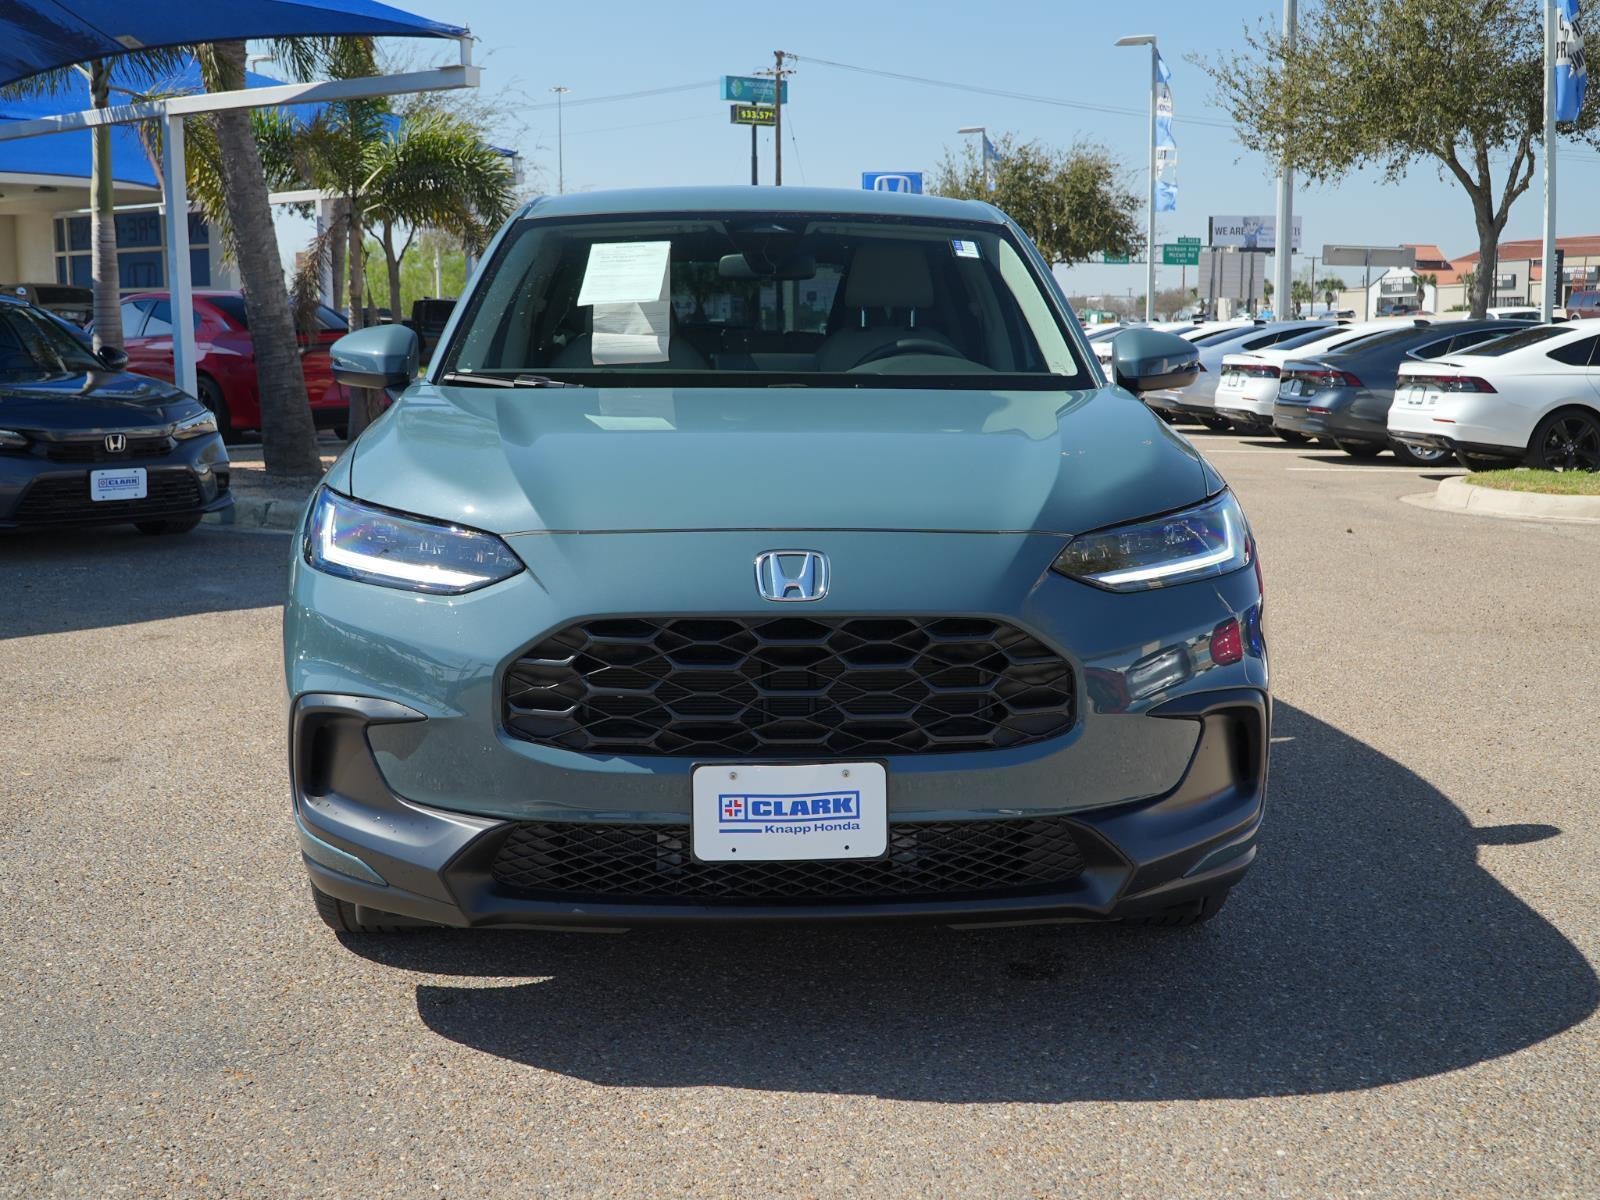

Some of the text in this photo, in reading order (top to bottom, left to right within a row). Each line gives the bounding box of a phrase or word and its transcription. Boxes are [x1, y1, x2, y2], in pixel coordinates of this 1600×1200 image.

[1215, 227, 1245, 236] WE ARE
[751, 797, 853, 817] CLARK
[765, 822, 860, 835] Knapp Honda
